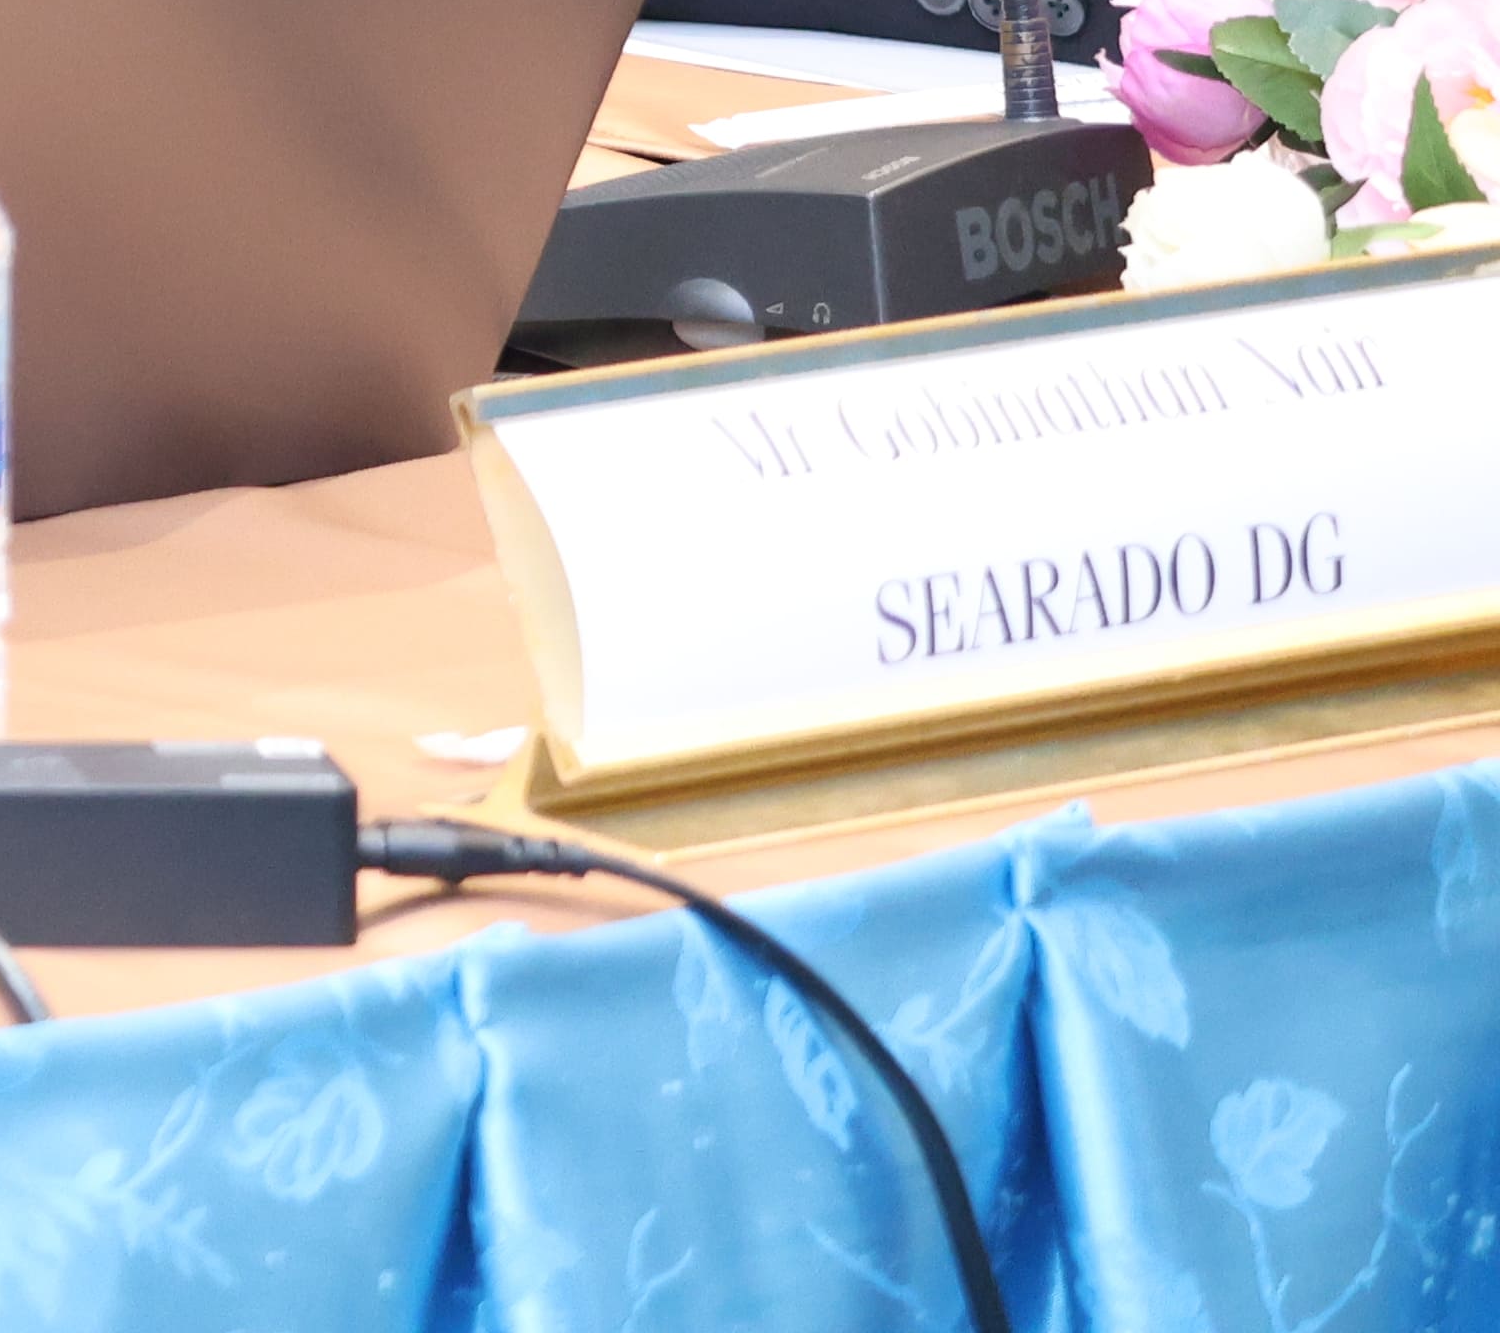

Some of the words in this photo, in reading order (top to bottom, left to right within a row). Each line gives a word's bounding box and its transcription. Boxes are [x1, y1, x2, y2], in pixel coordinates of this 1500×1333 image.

[956, 171, 1133, 281] BOSCH
[1236, 326, 1387, 405] Nair
[874, 532, 1216, 666] SEARADO
[1247, 511, 1346, 606] DG
